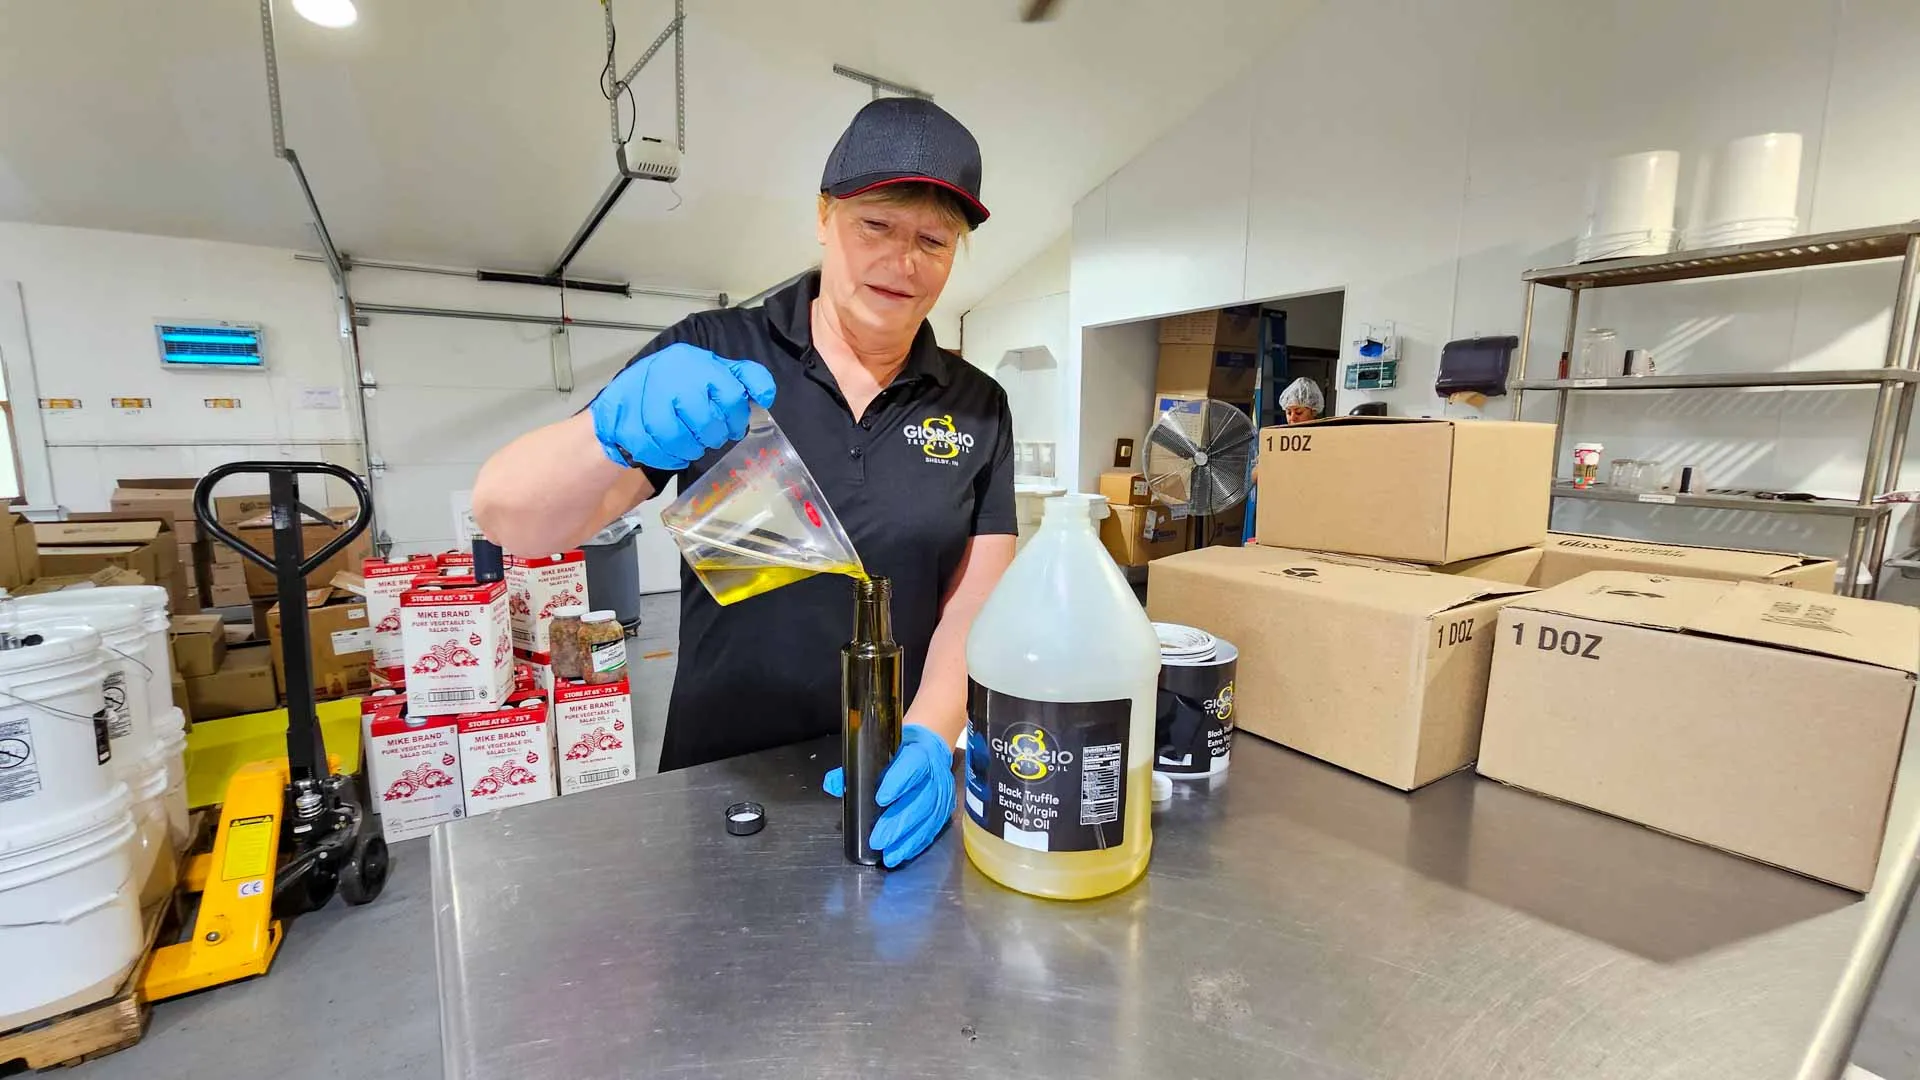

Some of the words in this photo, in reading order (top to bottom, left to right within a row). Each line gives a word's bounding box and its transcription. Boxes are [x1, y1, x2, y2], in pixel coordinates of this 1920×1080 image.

[903, 425, 974, 447] GIORGIO
[1266, 436, 1272, 451] 1
[1280, 435, 1312, 451] DOZ
[1438, 625, 1444, 648] 1
[1449, 618, 1474, 646] DOZ
[1512, 623, 1525, 645] 1
[1538, 626, 1603, 660] DOZ
[569, 705, 590, 713] MIKE
[590, 701, 614, 710] BRAND
[580, 710, 610, 718] VEGETABLE
[468, 720, 490, 728] STORE
[387, 737, 410, 746] MIKE
[412, 732, 442, 743] BRAND
[474, 735, 496, 743] MIKE
[498, 730, 526, 740] BRAND
[401, 742, 437, 752] VEGETABLE
[487, 740, 521, 749] VEGETABLE
[998, 782, 1022, 799] Black
[1025, 791, 1060, 805] Truffle
[998, 795, 1022, 812] Extra
[1025, 804, 1058, 819] Virgin
[1004, 810, 1030, 826] Olive
[1033, 818, 1050, 830] Oil
